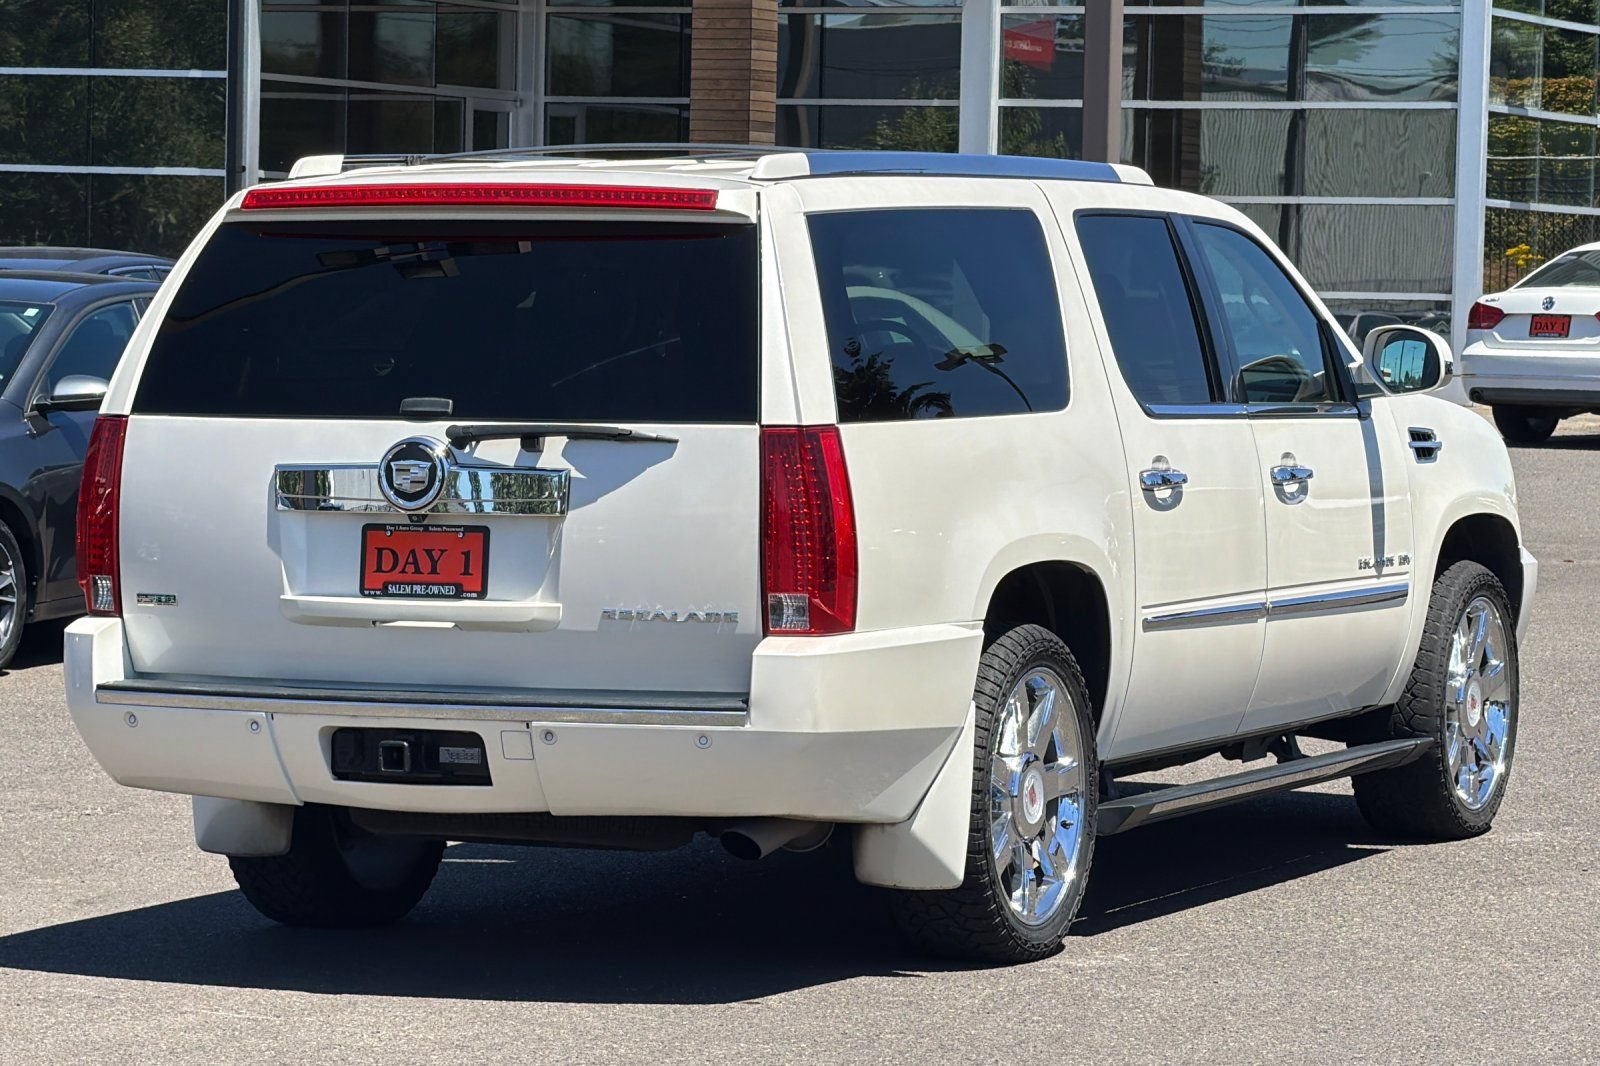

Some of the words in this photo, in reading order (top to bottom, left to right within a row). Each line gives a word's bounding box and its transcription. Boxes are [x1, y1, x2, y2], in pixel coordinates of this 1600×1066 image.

[1534, 321, 1557, 331] DAY
[1560, 321, 1566, 331] 1
[373, 547, 447, 575] DAY
[460, 550, 473, 576] 1
[387, 583, 411, 594] SALEM
[412, 584, 456, 595] PRE-OWNED
